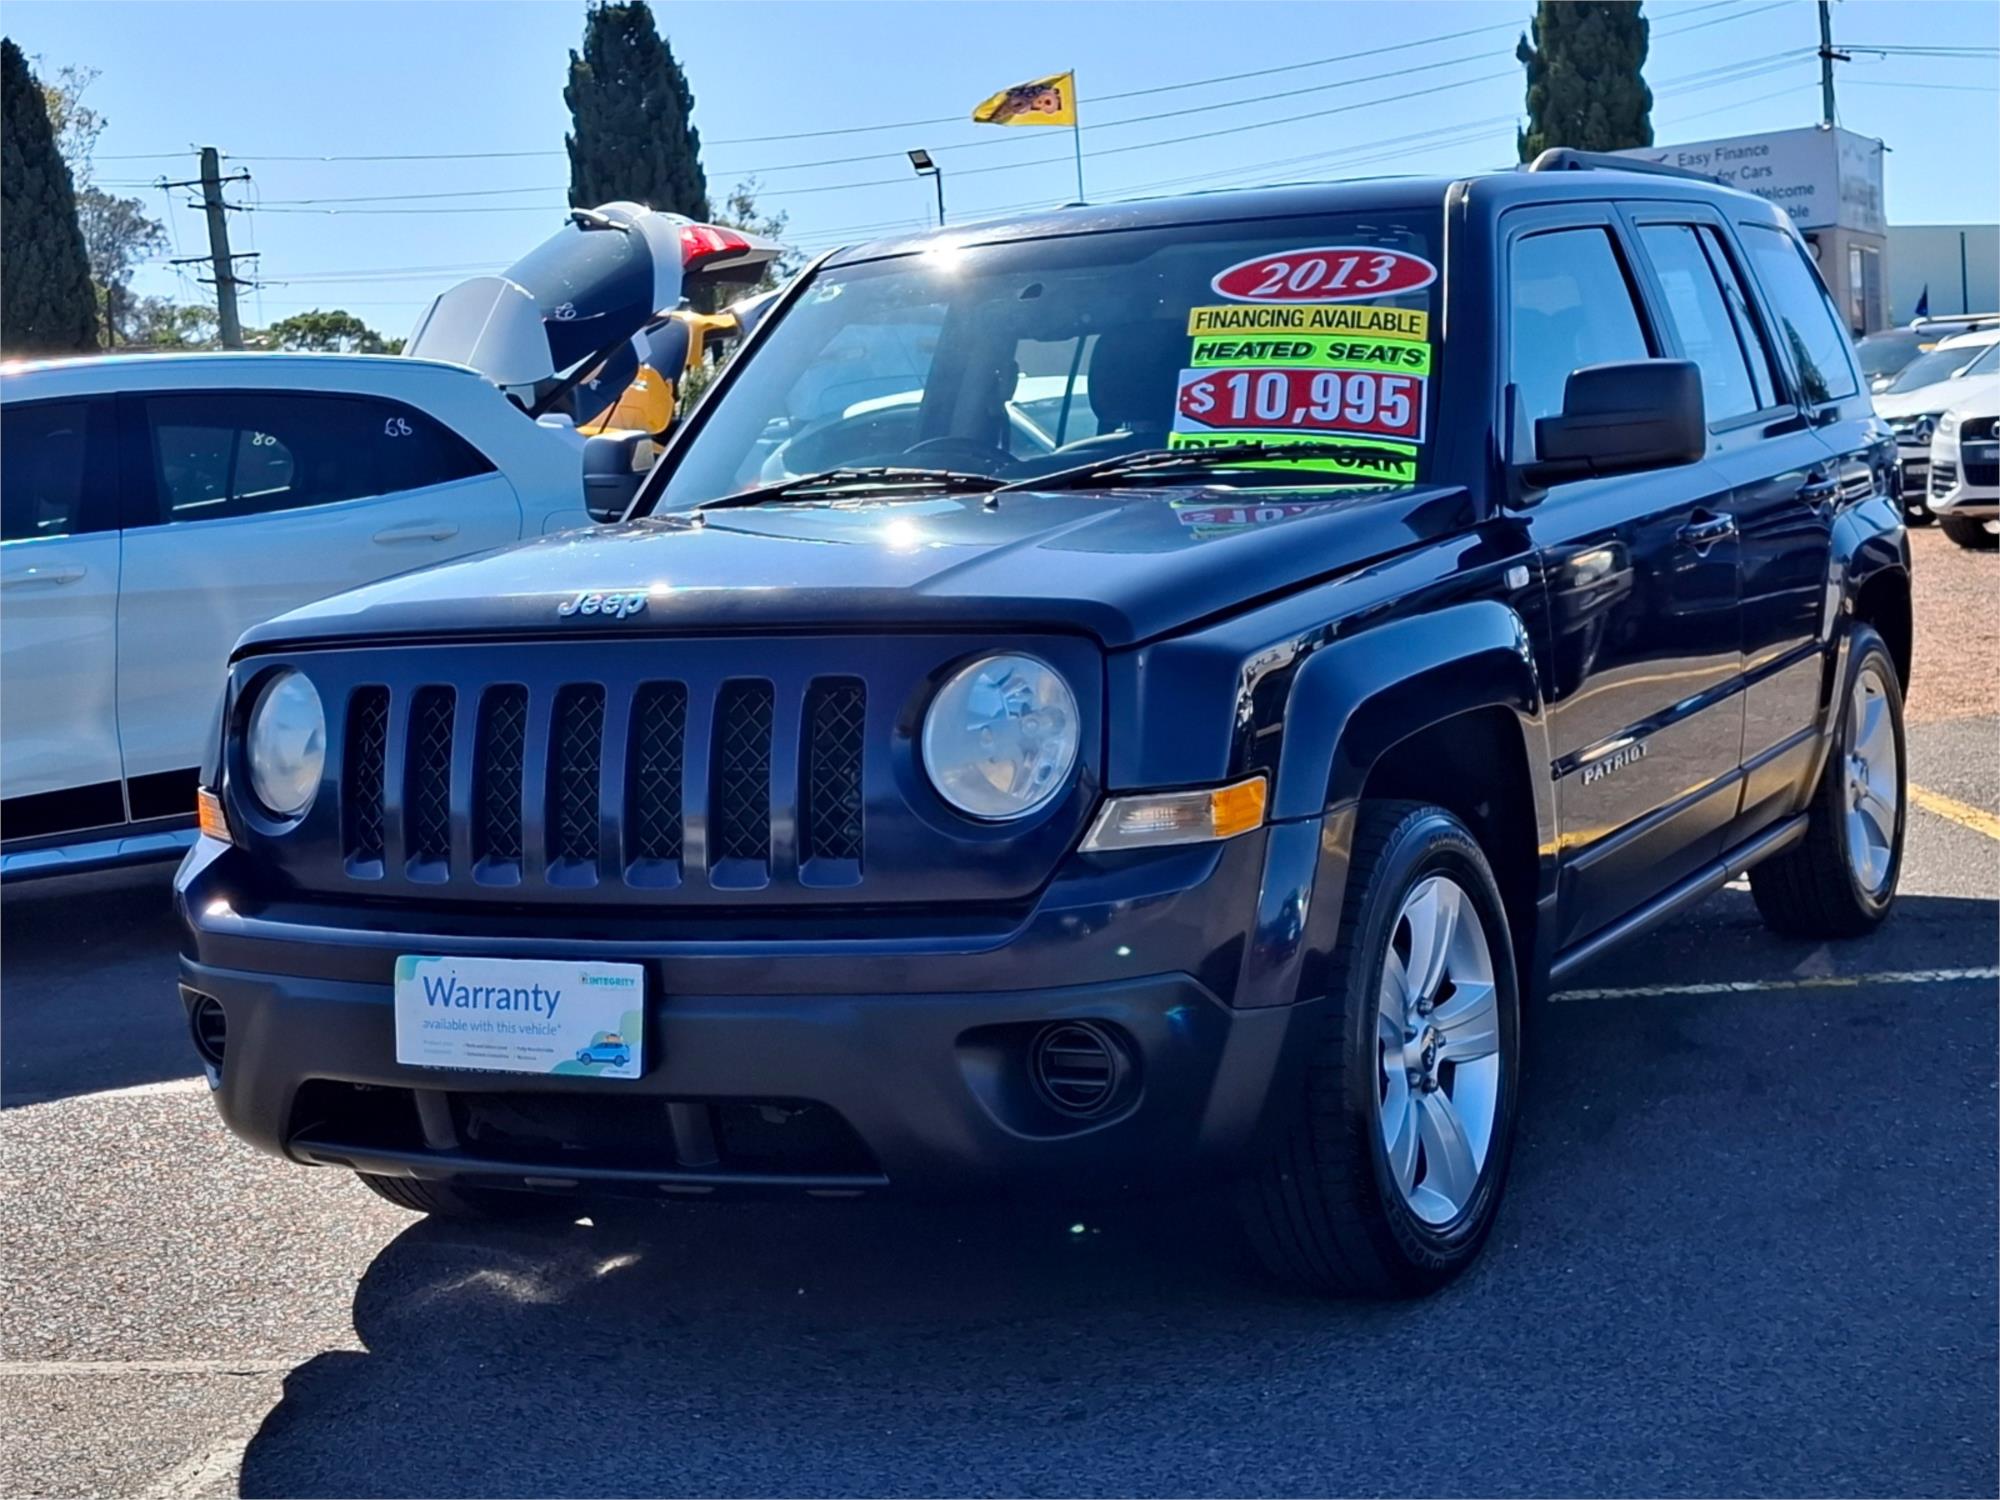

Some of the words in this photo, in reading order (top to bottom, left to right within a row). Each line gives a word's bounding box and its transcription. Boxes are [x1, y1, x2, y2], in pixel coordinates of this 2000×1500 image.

[1678, 152, 1711, 167] Easy
[1715, 144, 1770, 160] Finance
[1740, 166, 1773, 180] Cars
[1750, 184, 1815, 199] Welcome
[1248, 255, 1397, 295] 2013
[1195, 309, 1304, 330] FINANCING
[1309, 309, 1421, 334] AVAILABLE
[1194, 341, 1317, 360] HEATED
[1325, 342, 1427, 367] SEATS
[384, 417, 412, 437] 68
[558, 592, 648, 619] Jeep
[1582, 741, 1648, 785] PATRIOT
[590, 976, 635, 987] INTEGRITY
[423, 974, 561, 1019] Warranty
[422, 1019, 468, 1032] available
[470, 1020, 495, 1033] with
[497, 1021, 517, 1034] this
